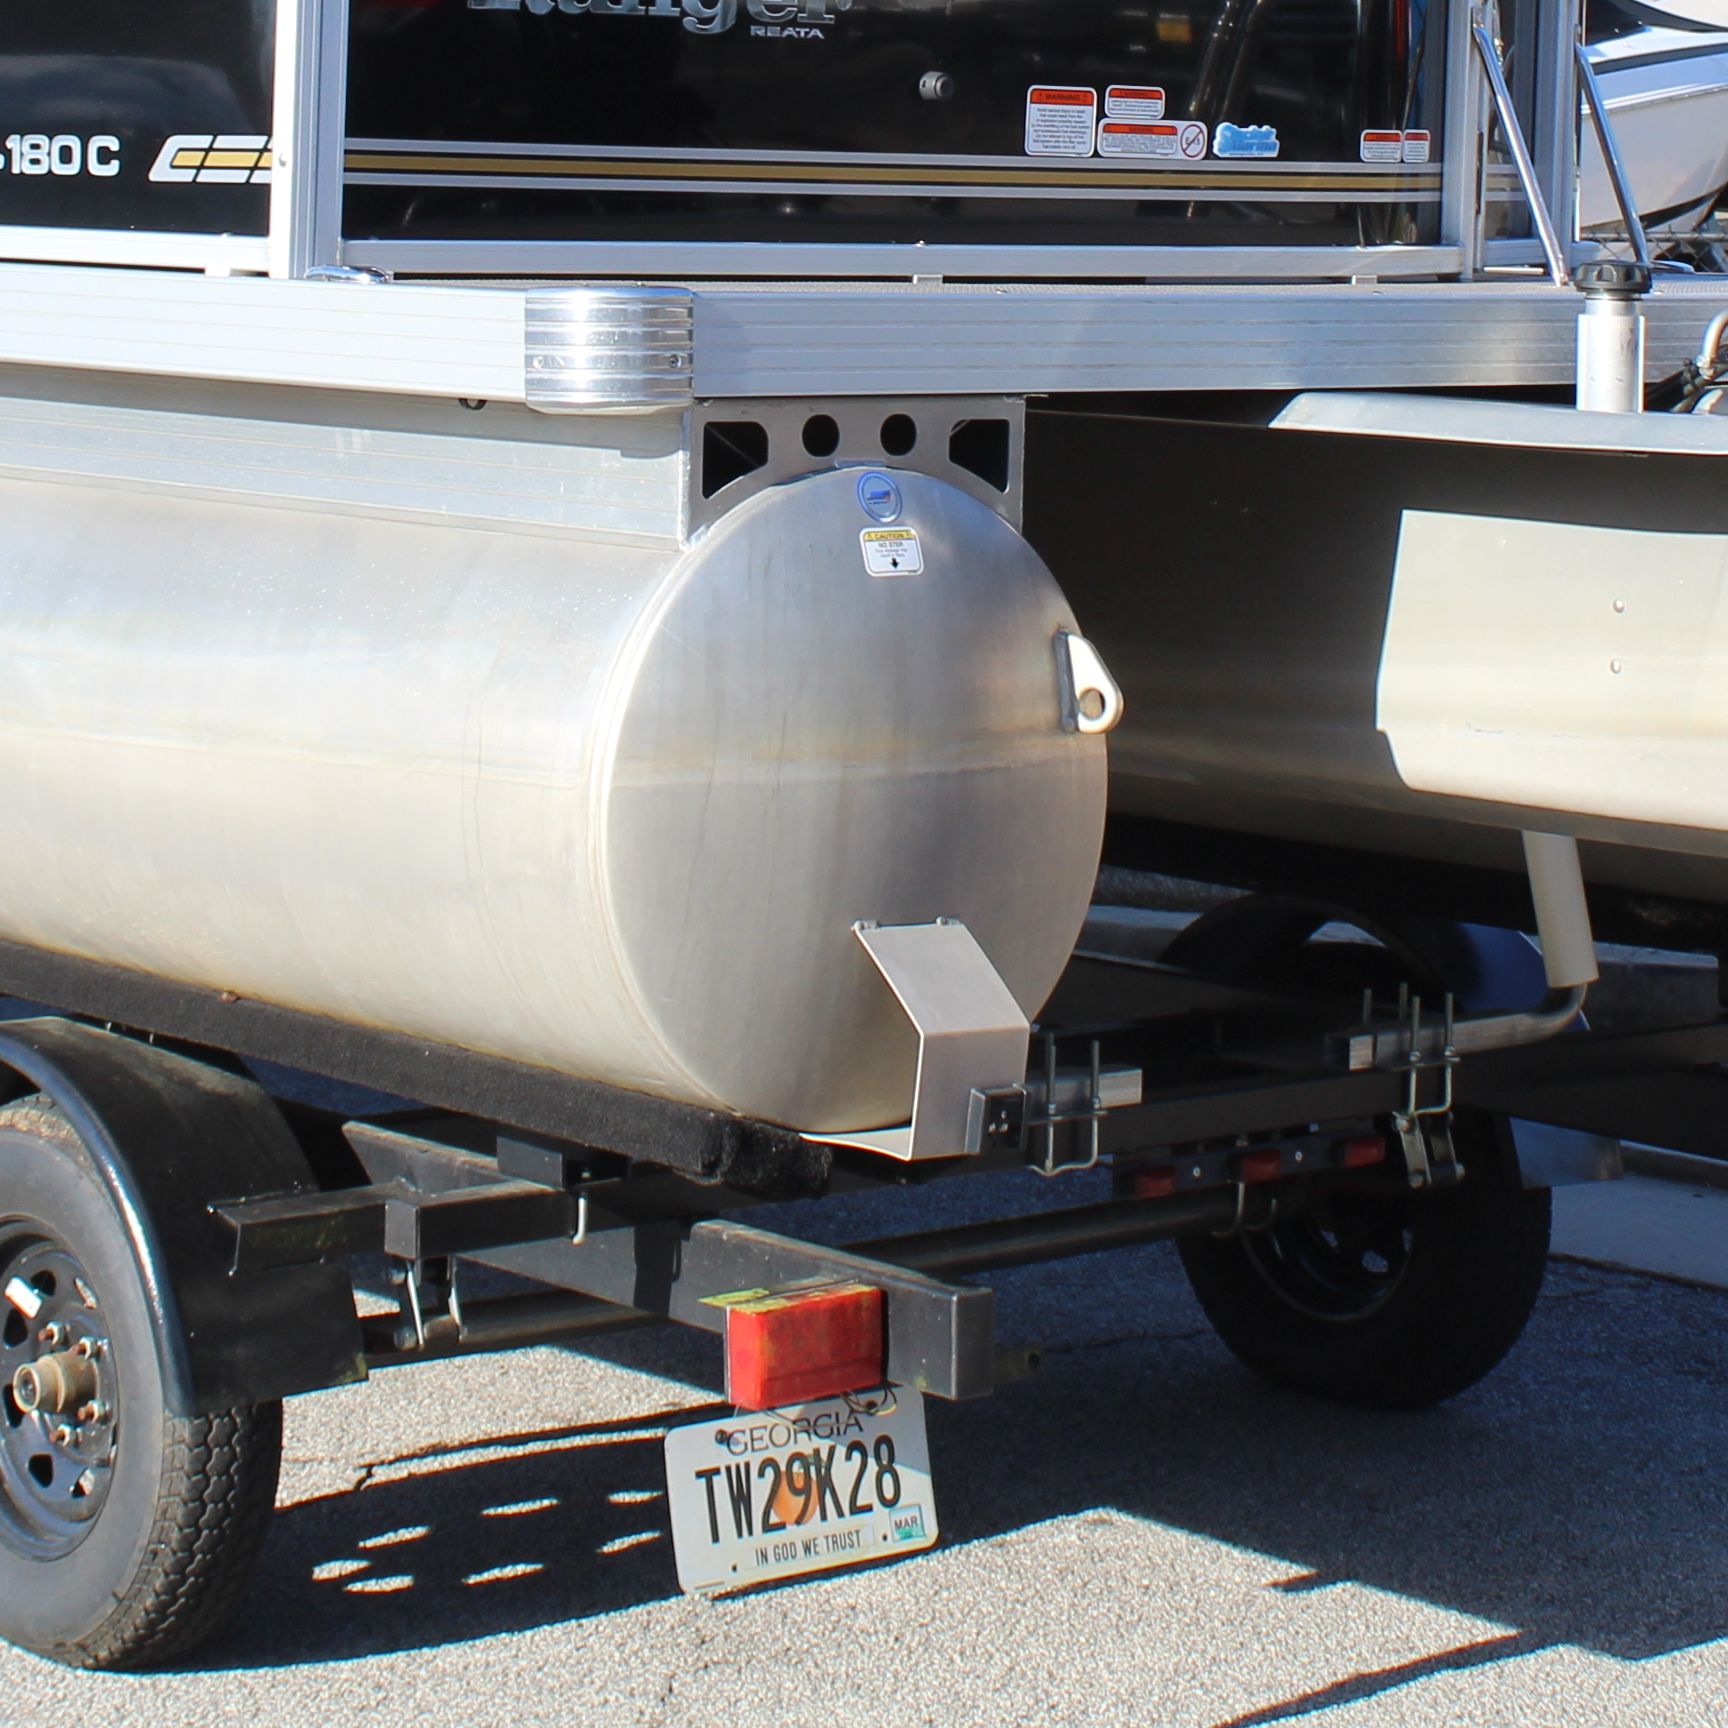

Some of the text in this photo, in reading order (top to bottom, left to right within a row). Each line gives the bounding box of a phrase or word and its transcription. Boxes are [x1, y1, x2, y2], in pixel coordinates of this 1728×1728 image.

[750, 25, 825, 40] REATA
[726, 1412, 864, 1456] GEORGIA
[694, 1434, 902, 1545] TW29K28
[894, 1515, 919, 1530] MAR
[755, 1529, 863, 1567] IN GOD WE TRUST
